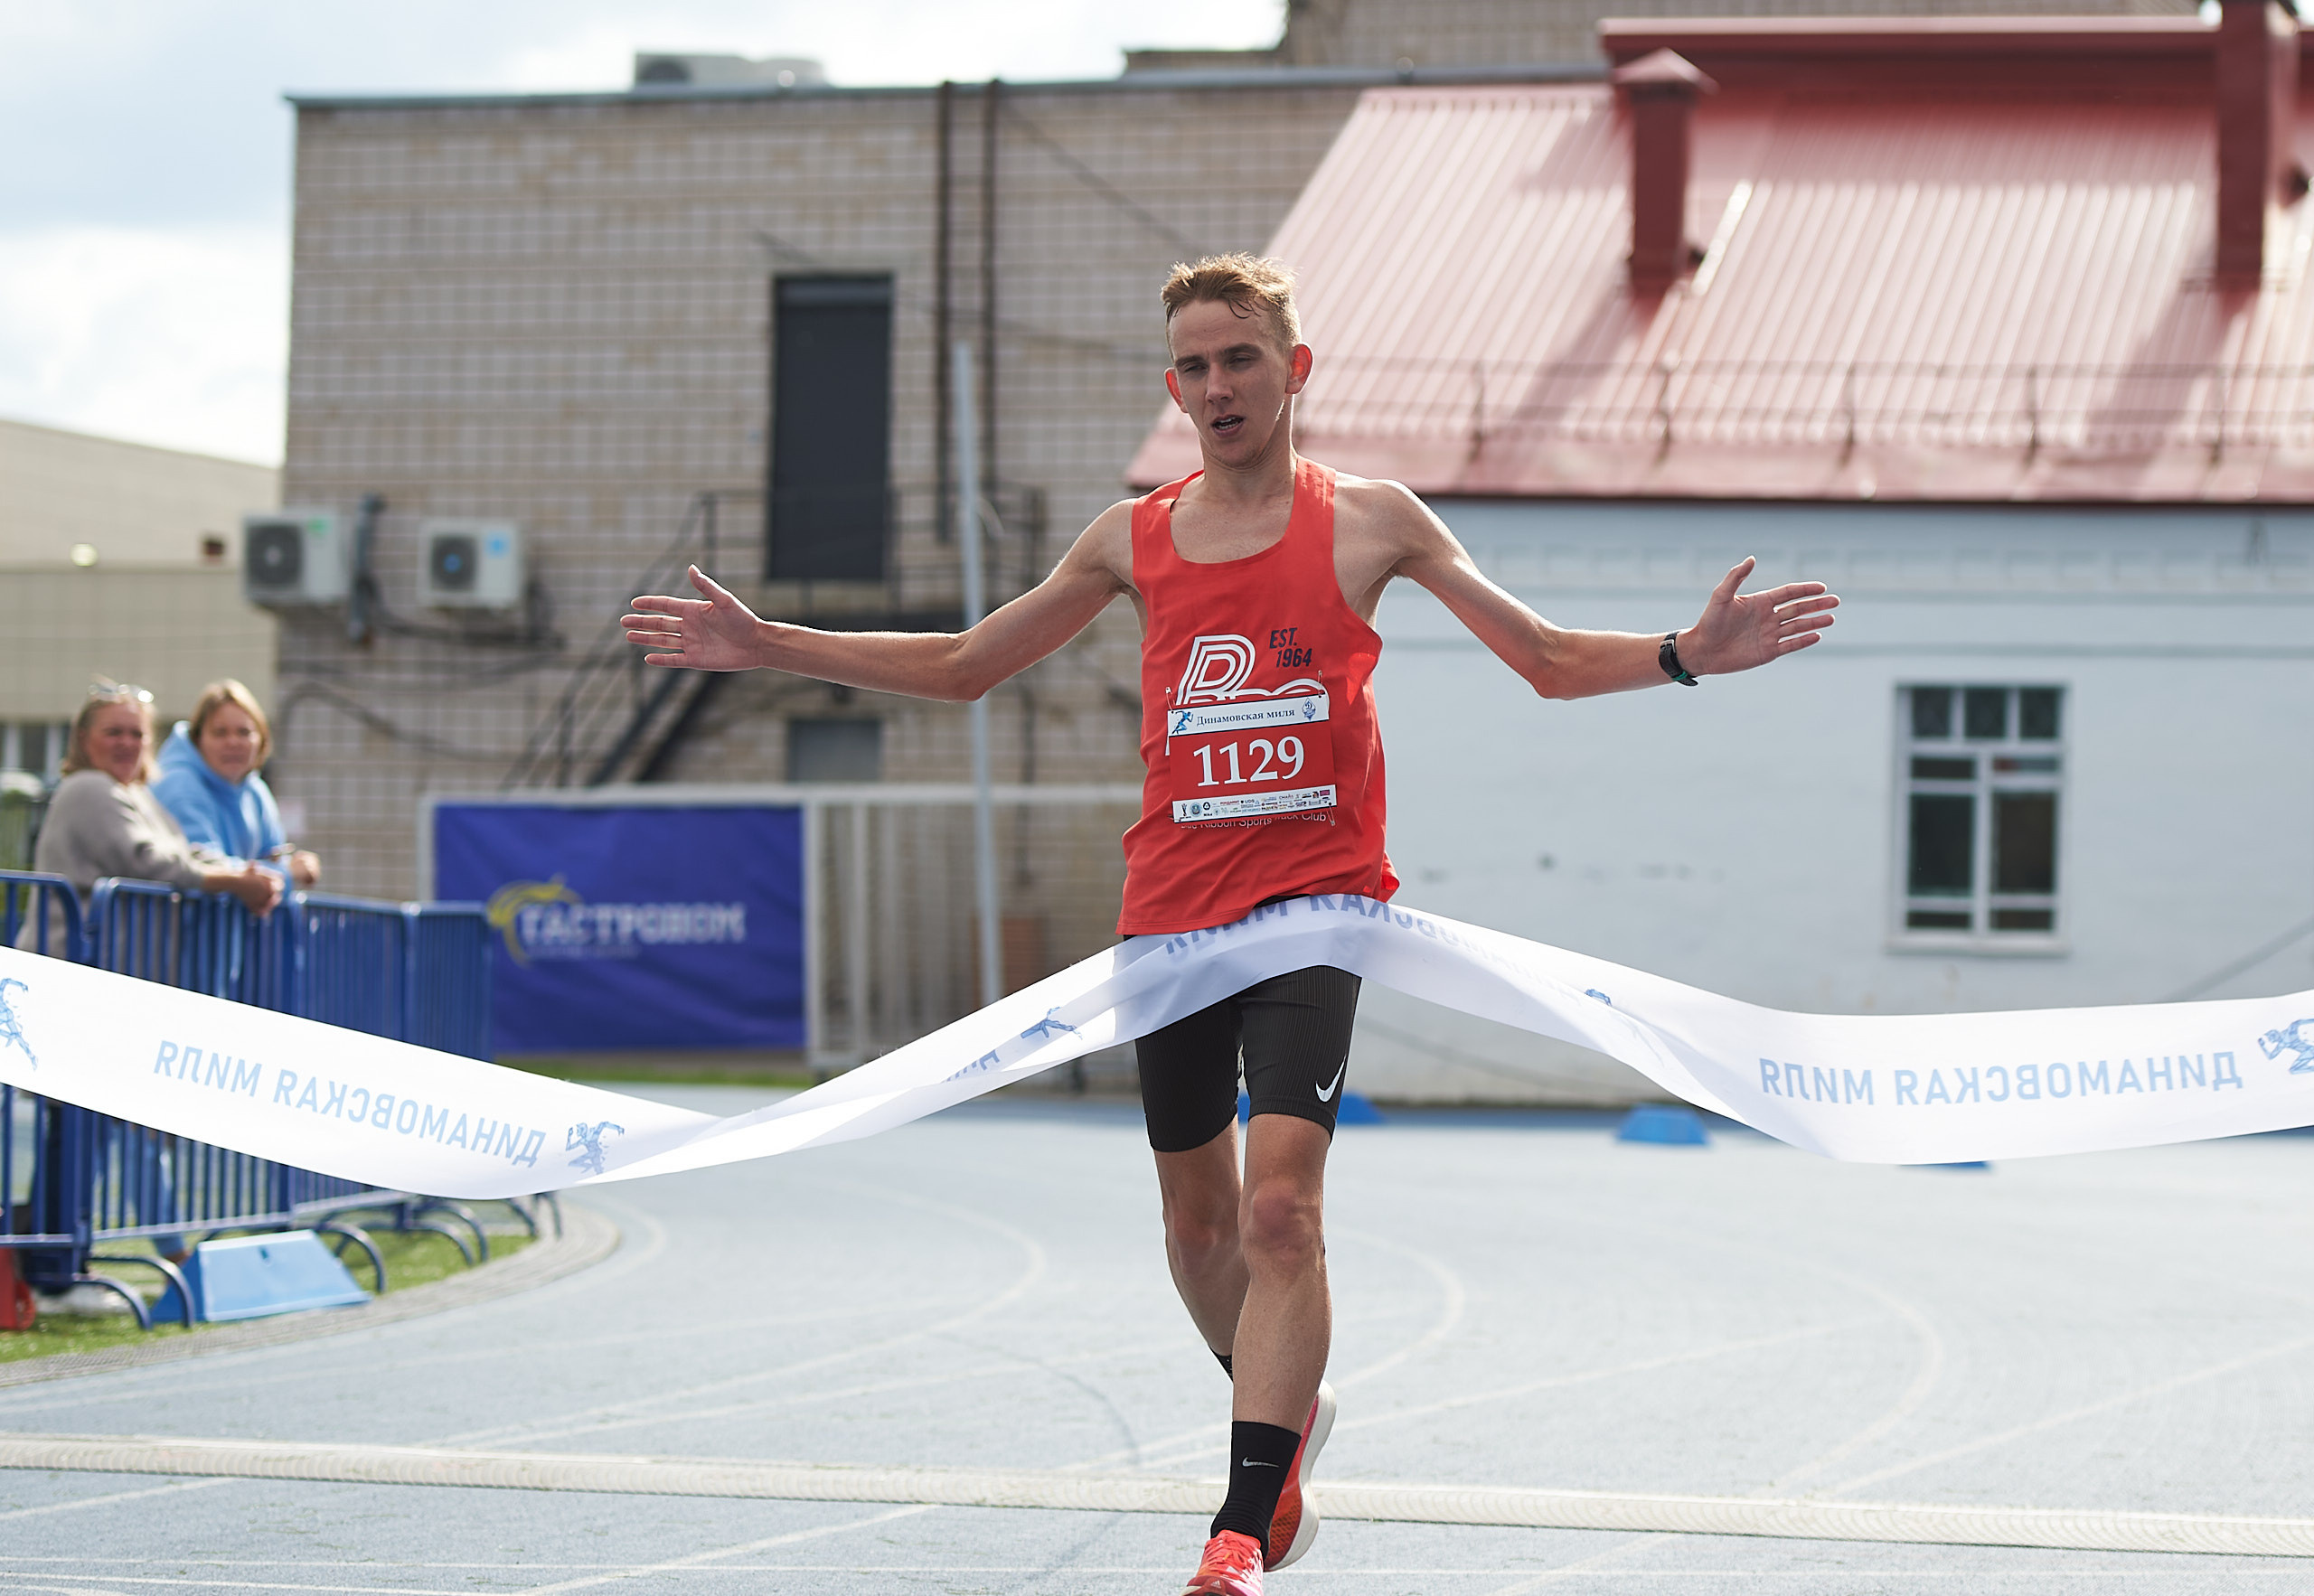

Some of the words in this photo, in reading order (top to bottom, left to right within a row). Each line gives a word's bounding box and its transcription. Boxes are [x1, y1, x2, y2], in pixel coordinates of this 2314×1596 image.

[1269, 627, 1298, 649] EST.
[1275, 648, 1312, 668] 1964
[1196, 711, 1264, 727] Динамовская
[1266, 709, 1295, 718] миля
[1192, 736, 1304, 787] 1129
[1302, 812, 1327, 821] Club
